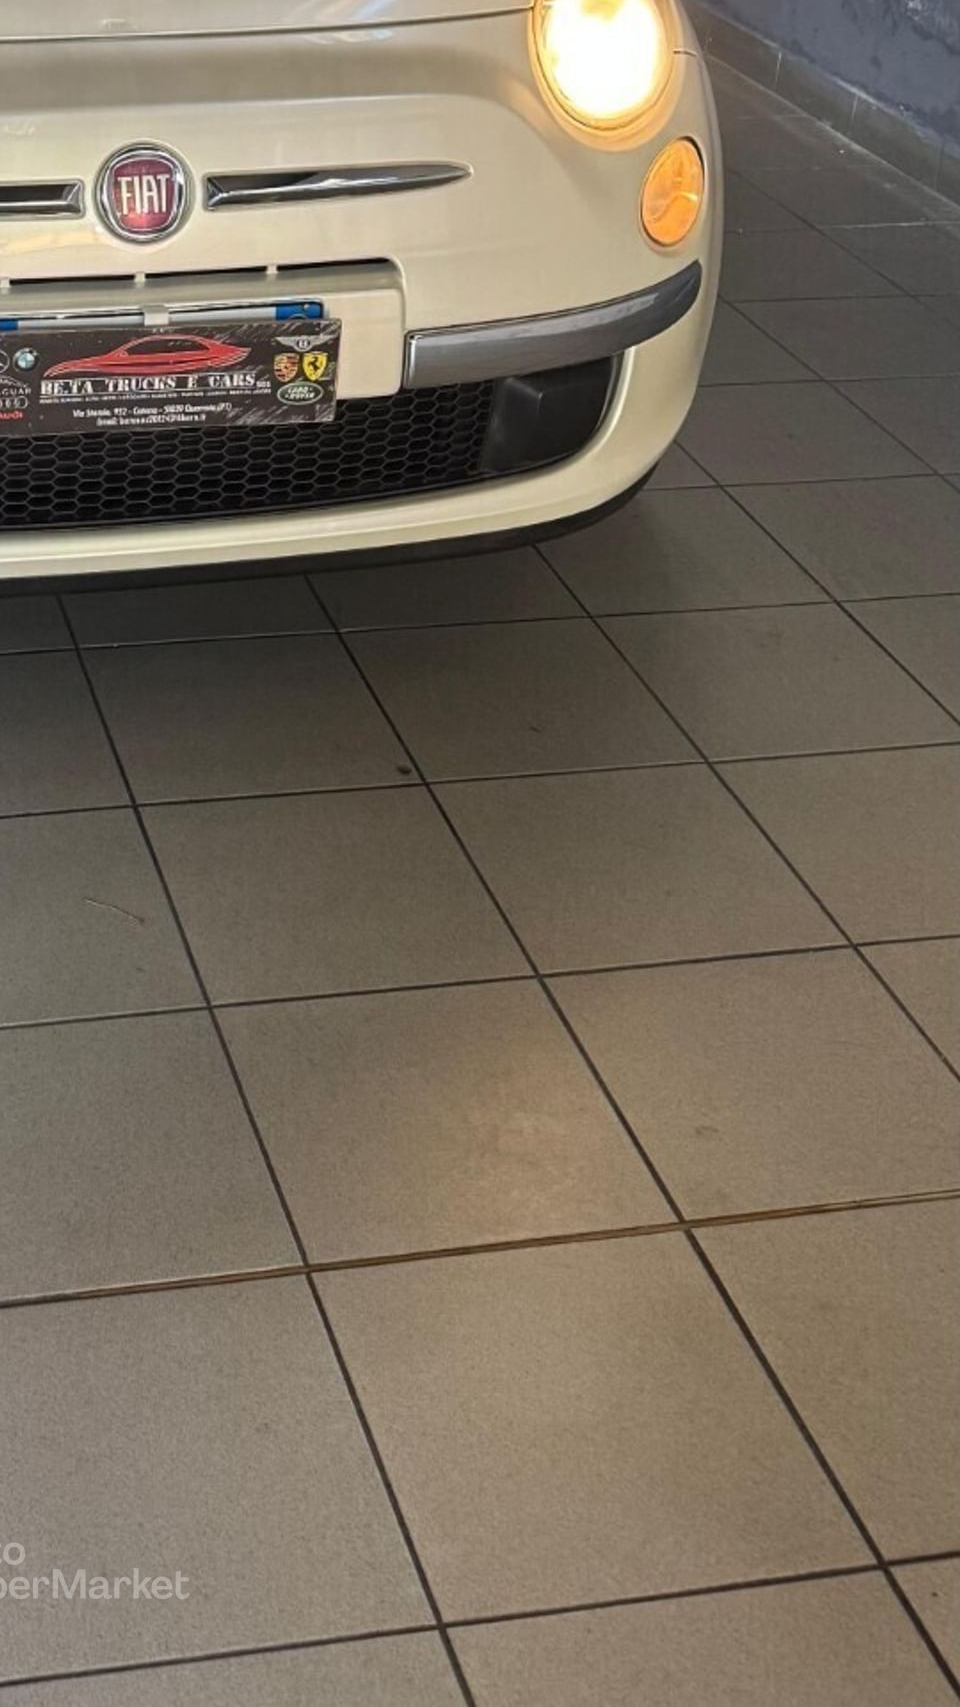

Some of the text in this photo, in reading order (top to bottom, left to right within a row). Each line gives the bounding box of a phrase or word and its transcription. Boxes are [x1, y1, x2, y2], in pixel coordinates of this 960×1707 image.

[117, 174, 170, 215] FIAT
[105, 376, 177, 393] TRUCKS
[187, 374, 199, 391] E
[208, 373, 256, 389] CARS
